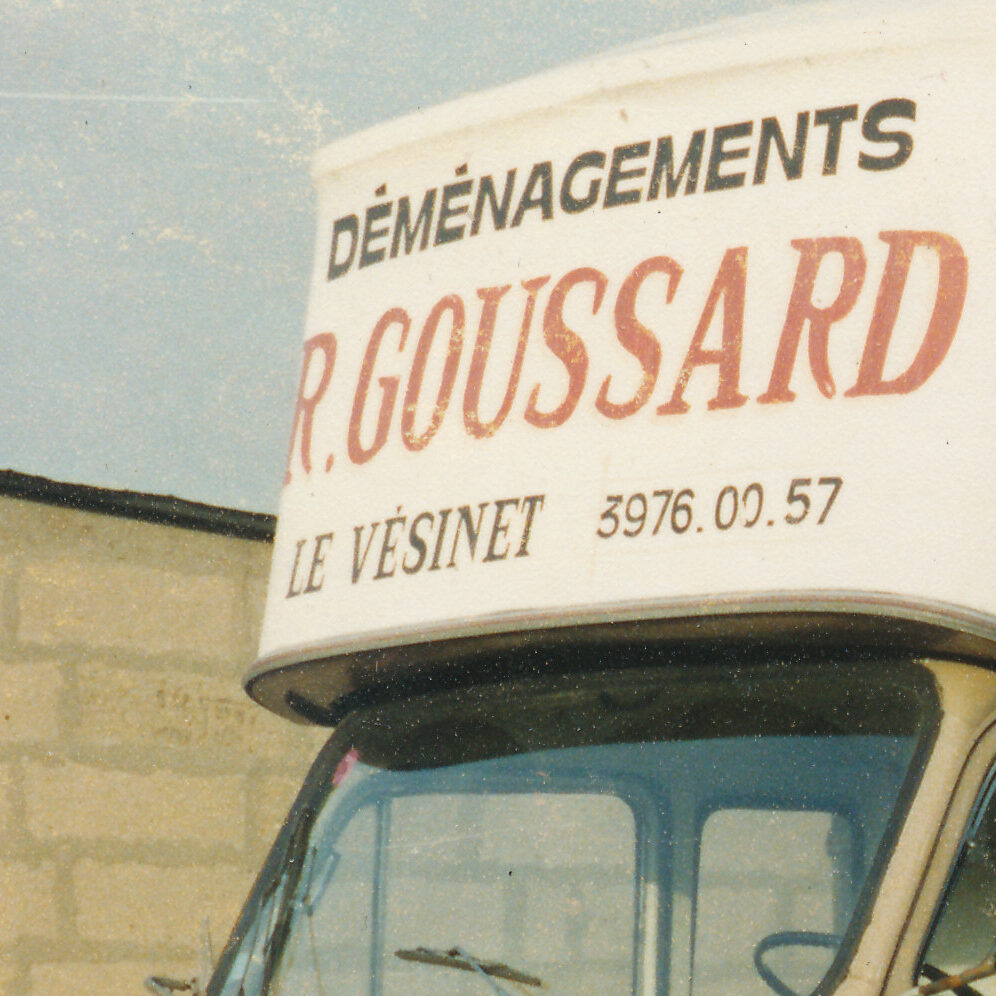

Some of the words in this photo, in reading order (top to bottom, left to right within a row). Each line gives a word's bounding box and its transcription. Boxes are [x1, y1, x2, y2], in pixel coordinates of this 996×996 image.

[326, 97, 917, 283] DÉMÉNAGEMENTS
[285, 532, 334, 599] LE
[350, 494, 545, 585] VÉSINET
